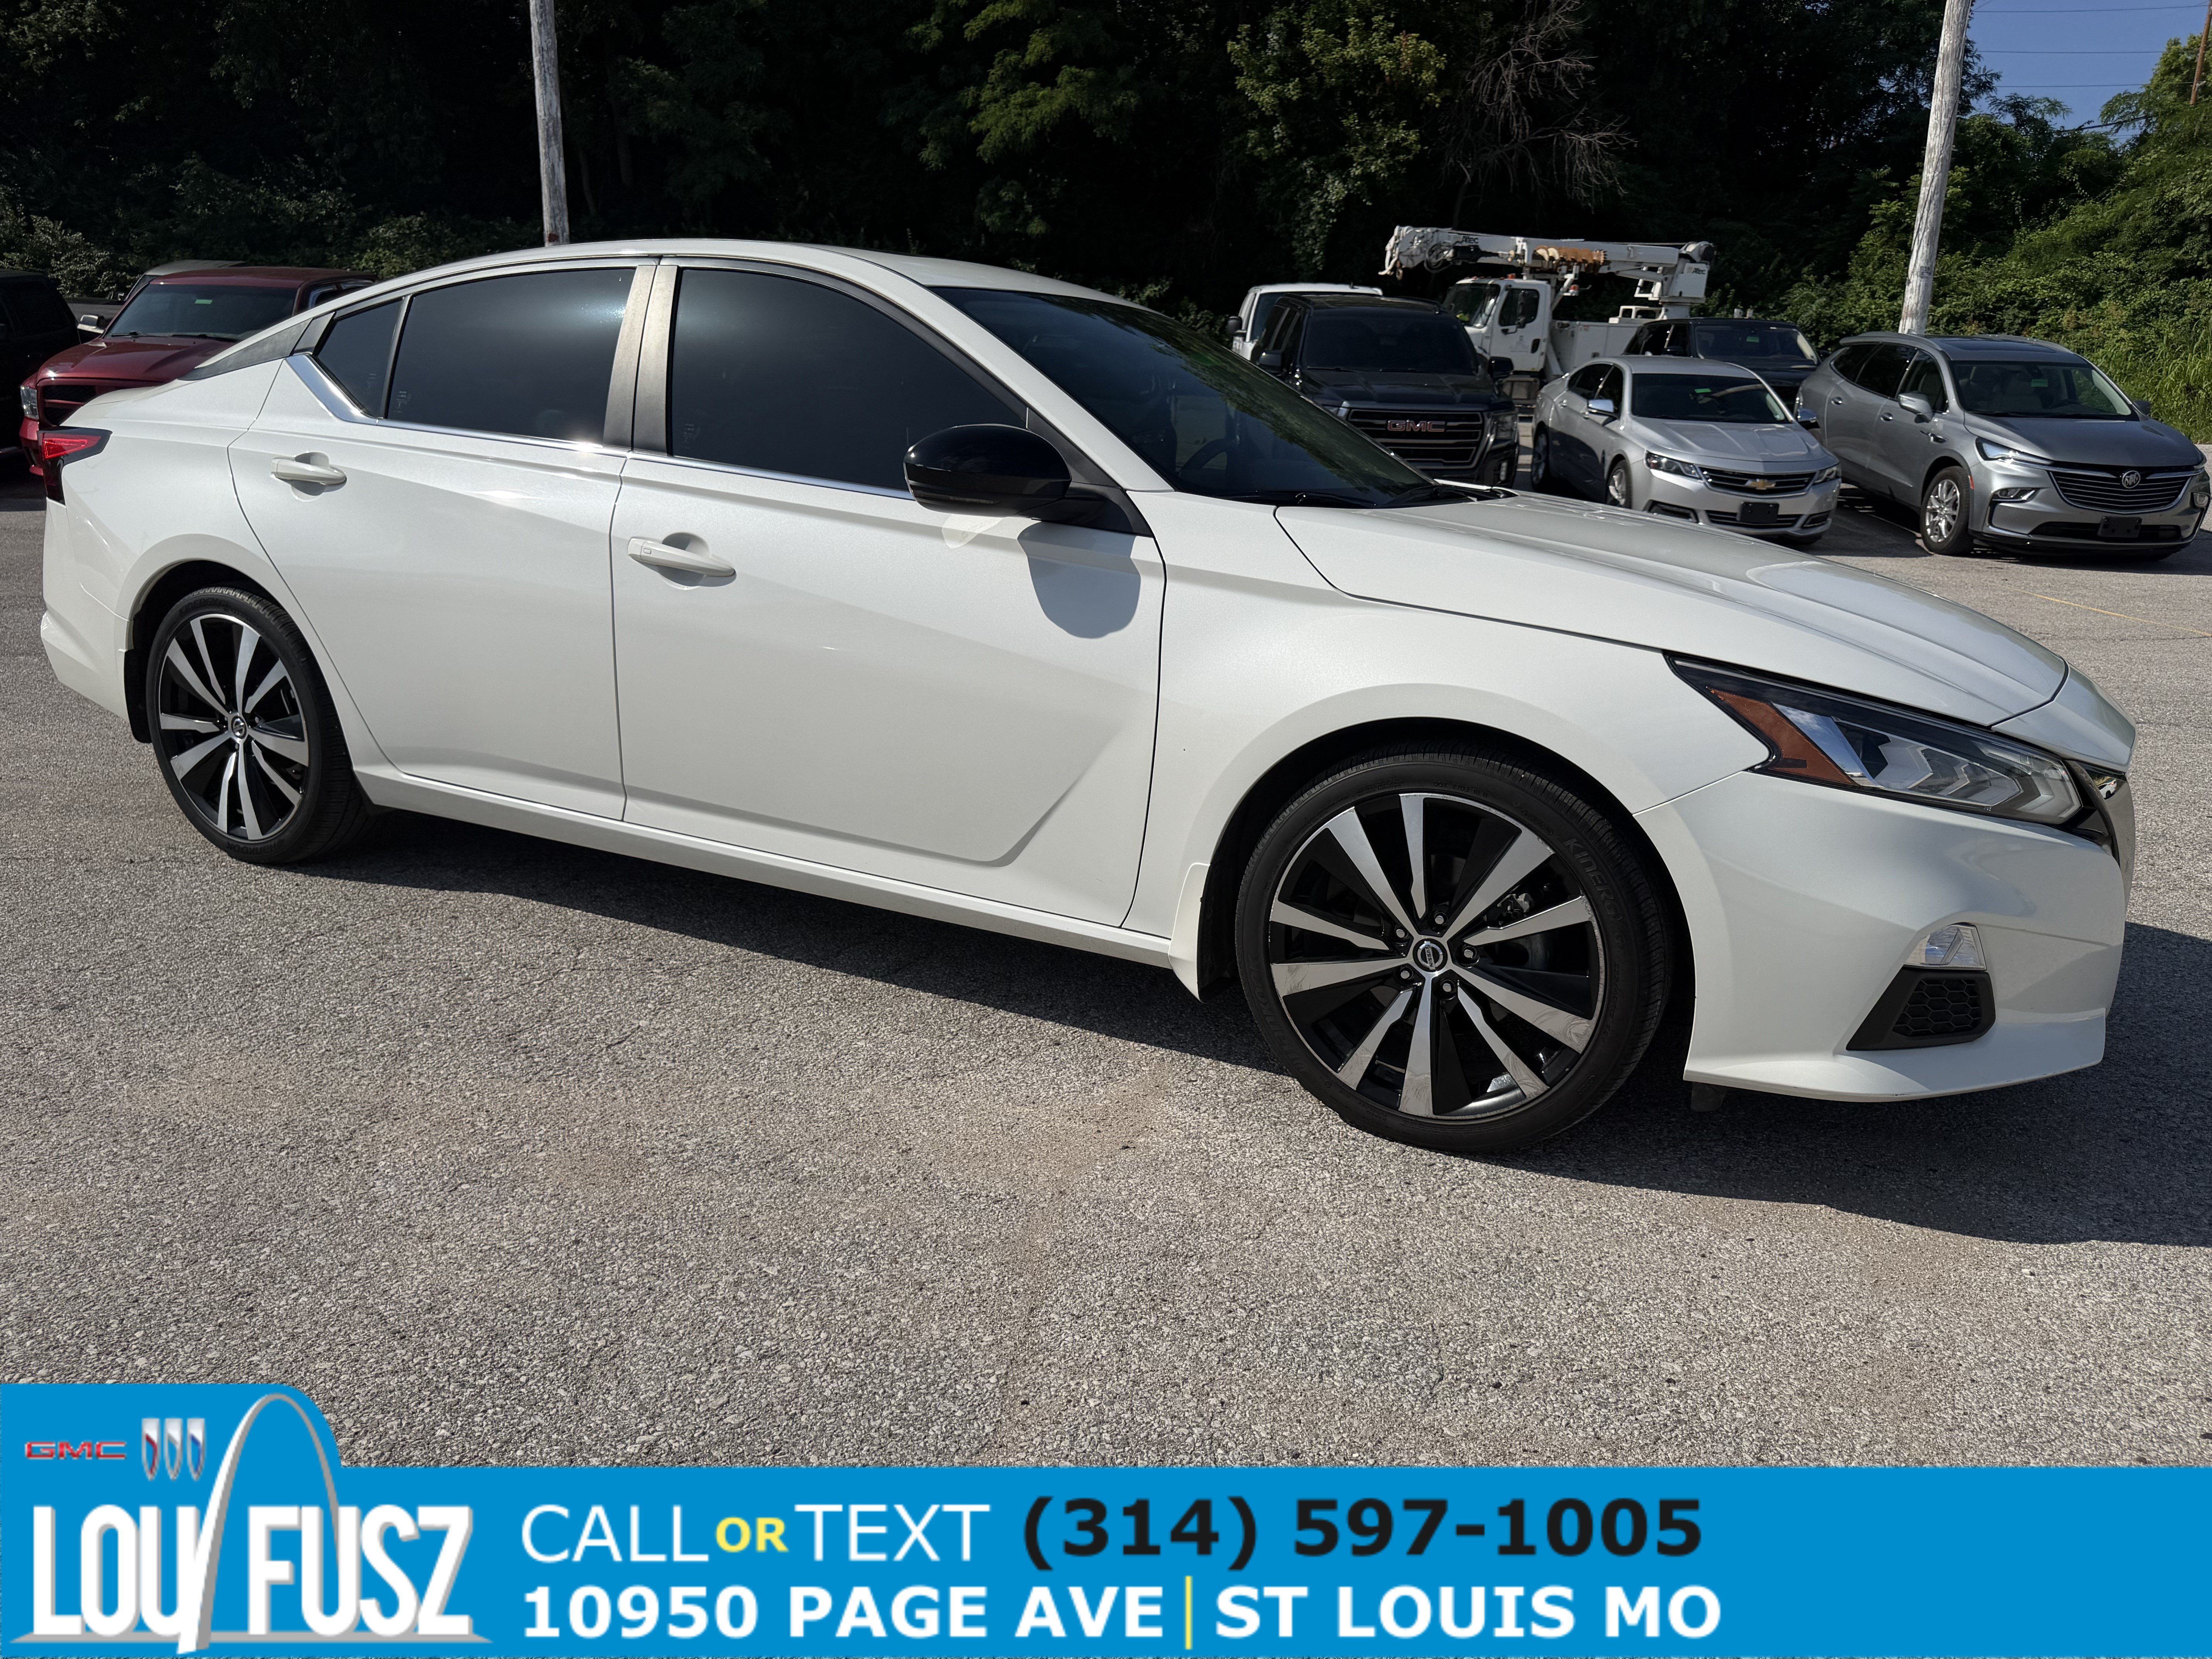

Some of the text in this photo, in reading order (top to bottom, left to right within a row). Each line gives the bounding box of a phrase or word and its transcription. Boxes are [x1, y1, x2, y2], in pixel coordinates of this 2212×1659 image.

[1462, 235, 1479, 244] Altec
[1387, 419, 1446, 432] GMC
[1563, 838, 1623, 922] KINERGY
[1425, 945, 1434, 967] NISSAN
